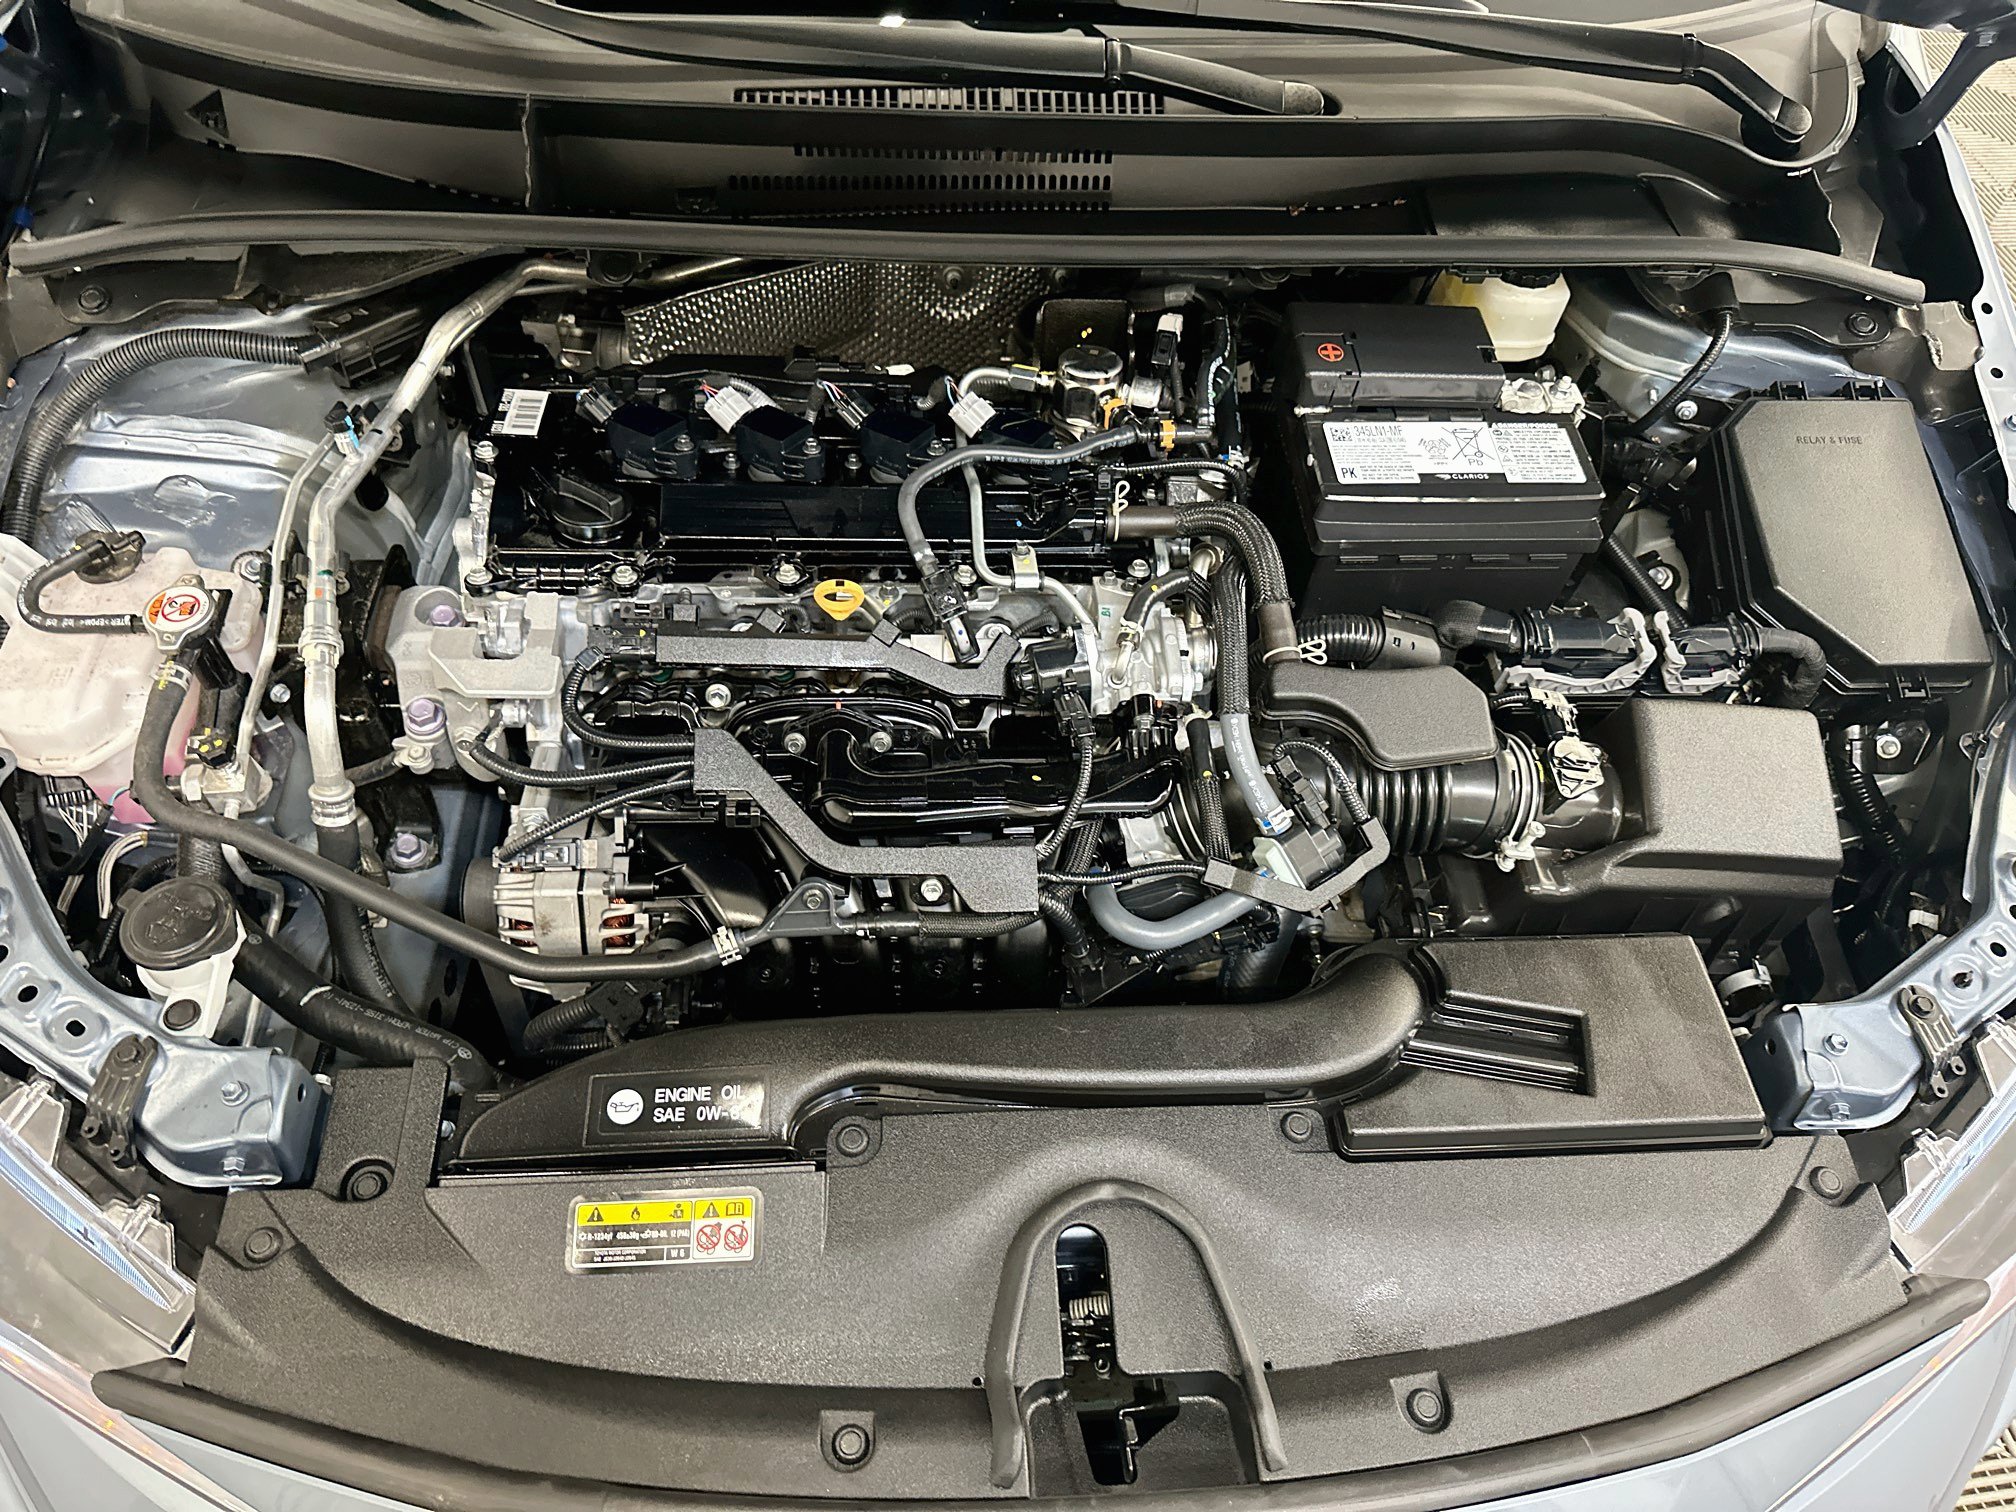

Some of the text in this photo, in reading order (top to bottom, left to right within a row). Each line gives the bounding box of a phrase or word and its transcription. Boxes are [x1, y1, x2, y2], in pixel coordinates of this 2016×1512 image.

[1353, 425, 1403, 437] 345LN1-MF
[1796, 435, 1863, 445] RELAY & FUSE
[1467, 458, 1484, 466] Pb
[1341, 467, 1358, 479] PK
[654, 1085, 746, 1103] ENGINE OIL
[653, 1107, 685, 1123] SAE
[670, 1249, 679, 1258] W
